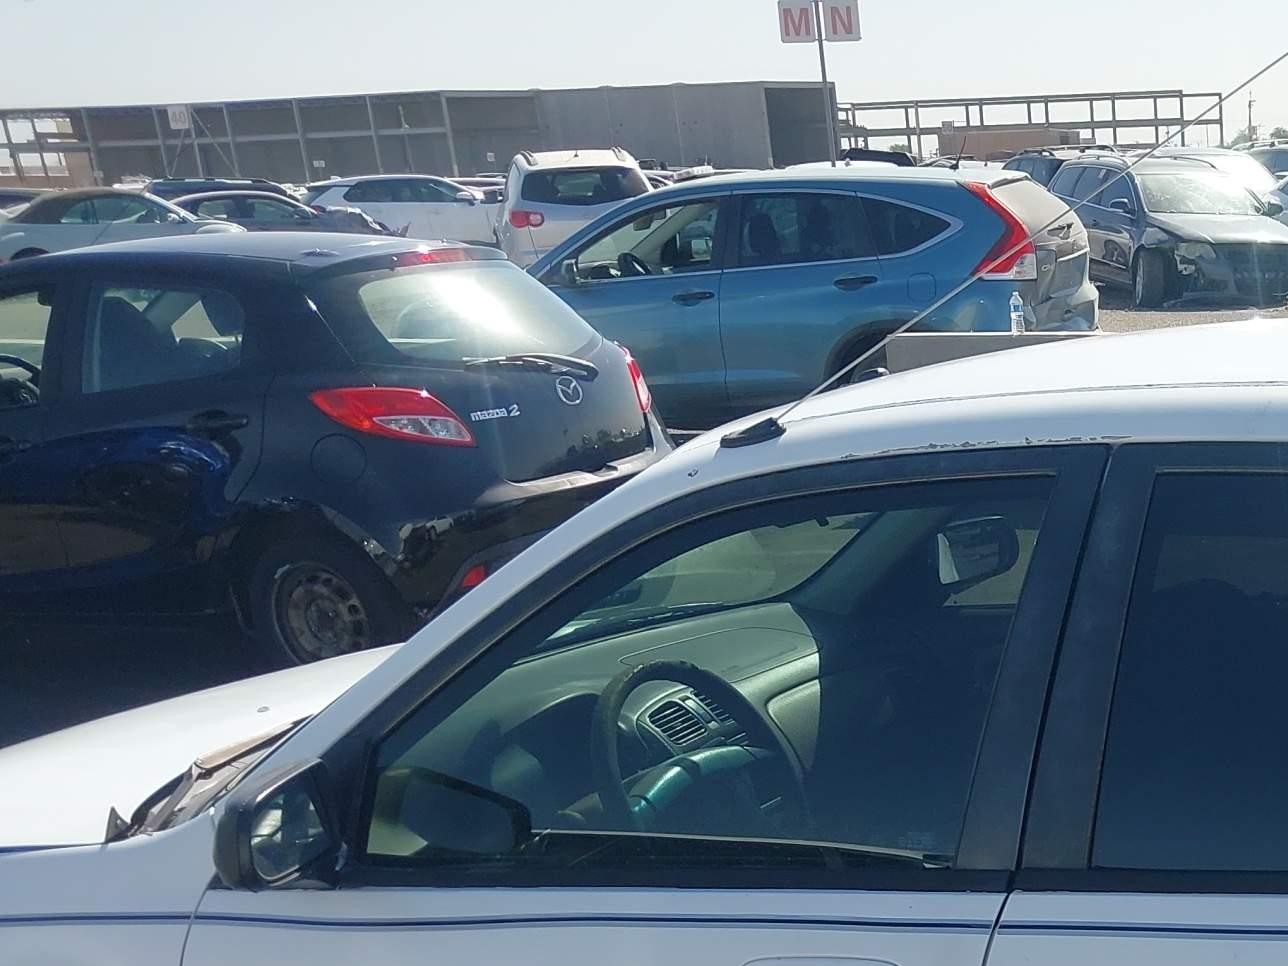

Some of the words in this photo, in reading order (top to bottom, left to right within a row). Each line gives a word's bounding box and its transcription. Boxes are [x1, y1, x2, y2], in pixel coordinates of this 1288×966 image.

[782, 7, 811, 36] M
[830, 6, 853, 34] N
[508, 404, 520, 416] 2
